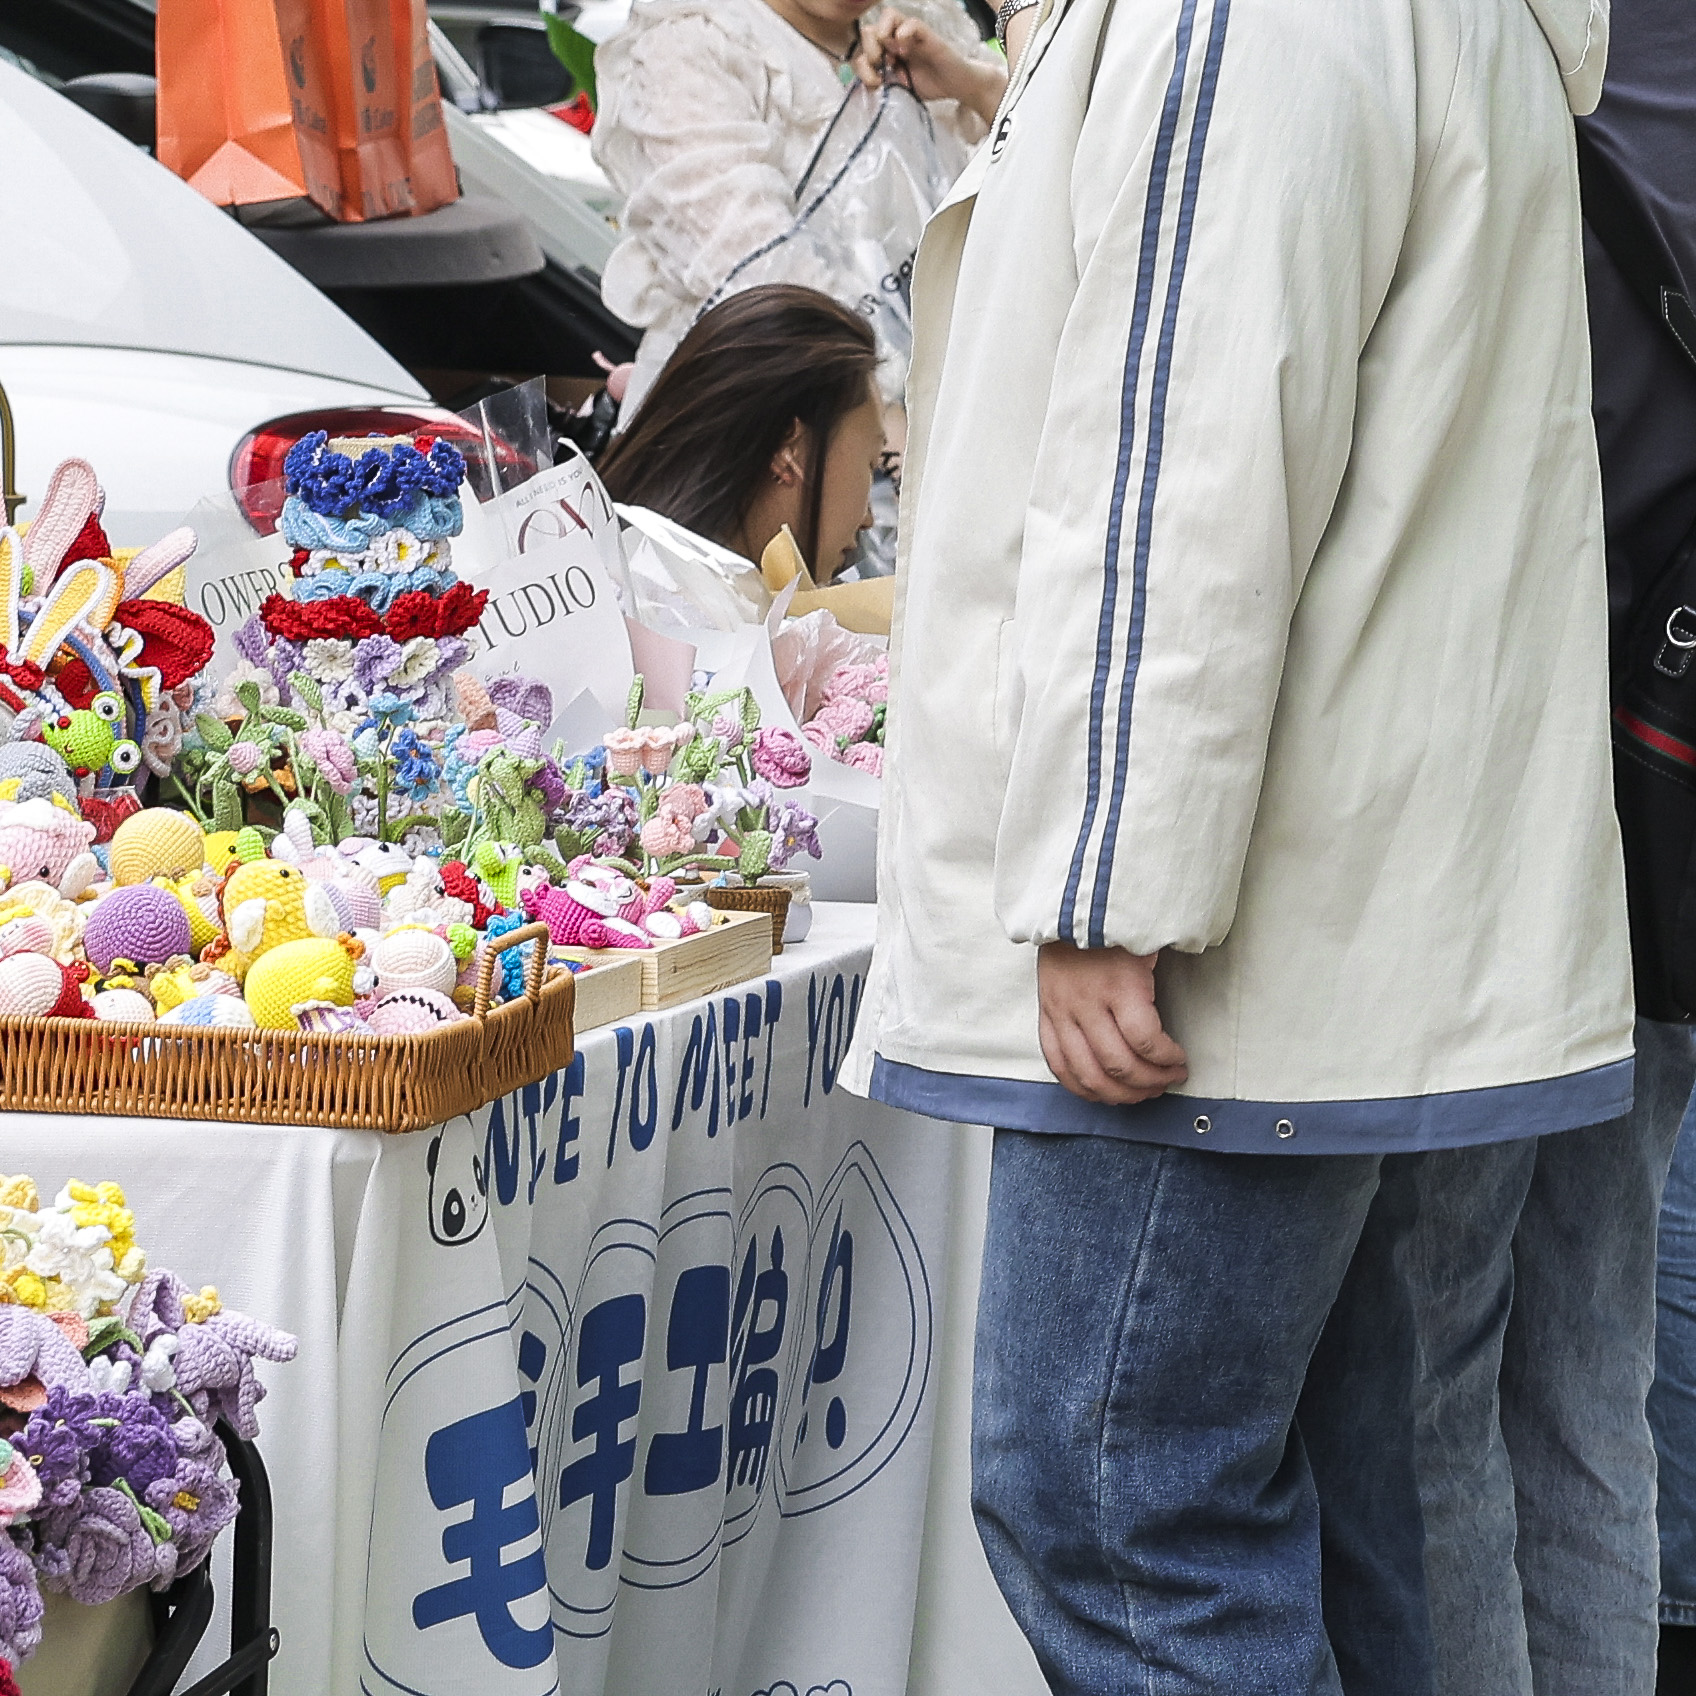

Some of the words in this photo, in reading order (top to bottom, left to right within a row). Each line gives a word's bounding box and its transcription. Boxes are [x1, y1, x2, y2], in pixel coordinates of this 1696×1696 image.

[183, 562, 290, 626] OWER
[467, 565, 597, 662] TUDIO
[606, 1022, 658, 1169] TO
[671, 979, 783, 1139] MEET
